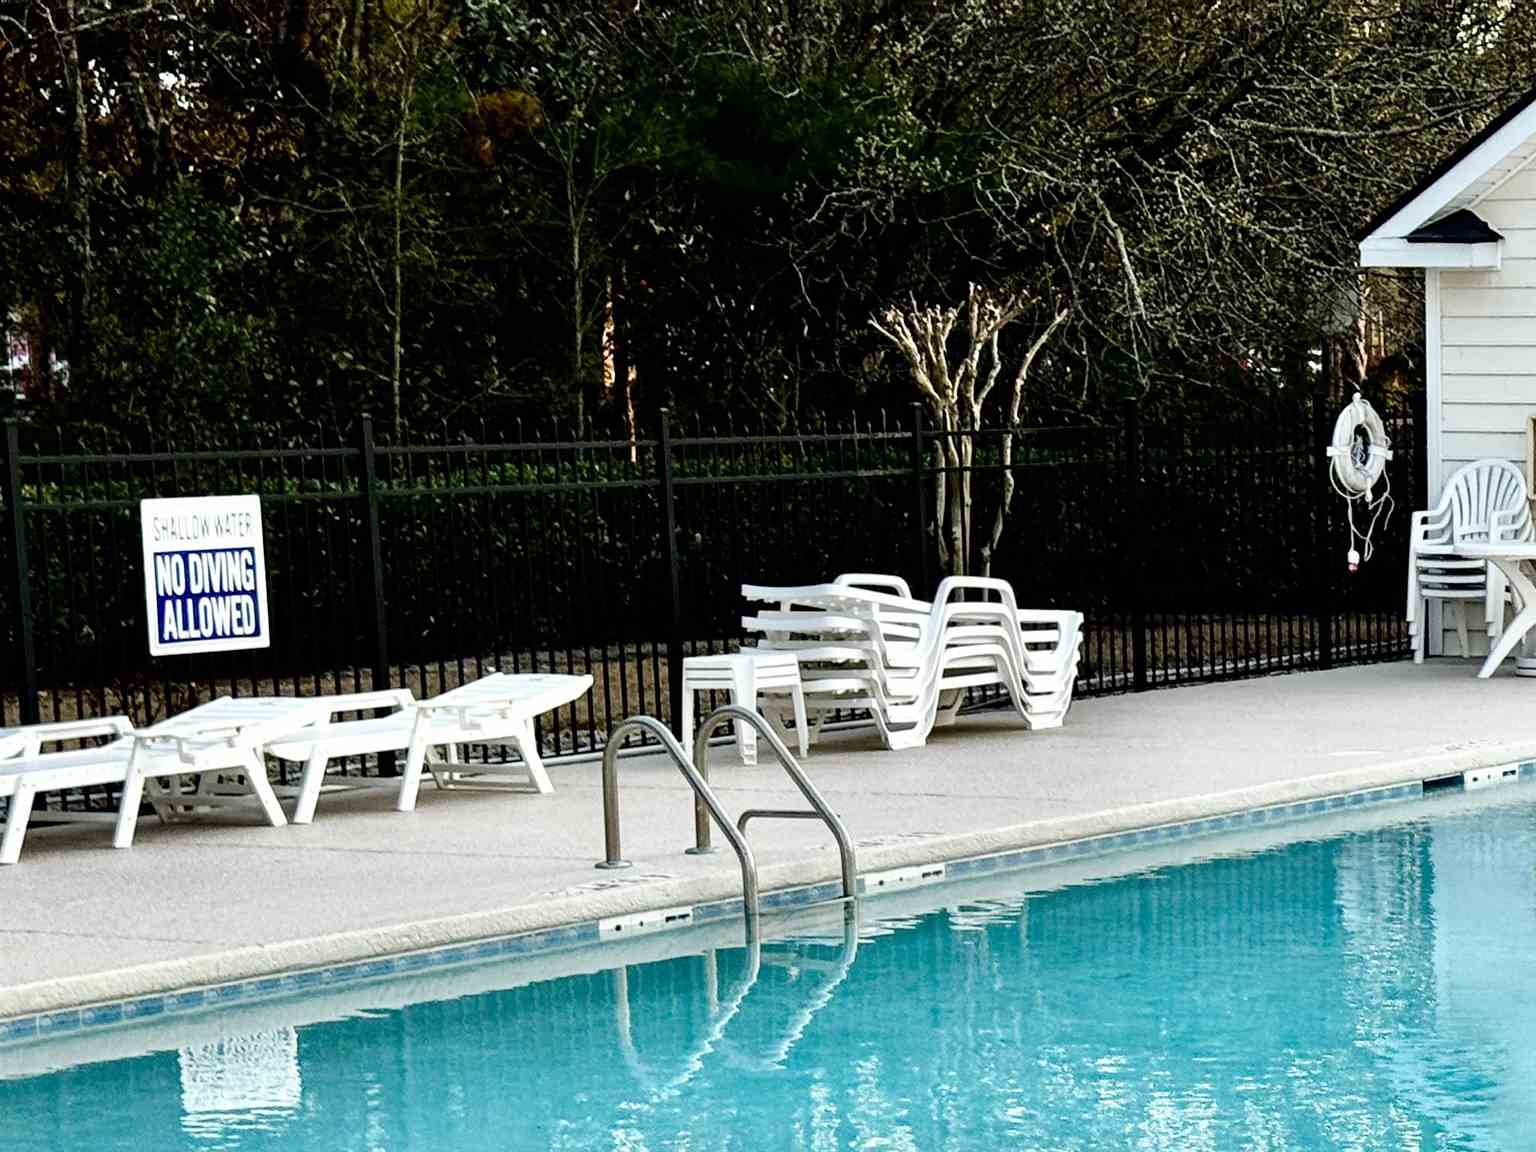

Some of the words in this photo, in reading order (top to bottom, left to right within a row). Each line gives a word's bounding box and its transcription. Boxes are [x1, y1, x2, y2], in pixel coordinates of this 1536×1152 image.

[153, 515, 210, 541] SHALLOW
[214, 512, 252, 537] WATER
[156, 553, 186, 596] NO
[188, 549, 255, 594] DIVING
[163, 594, 256, 640] ALLOWED
